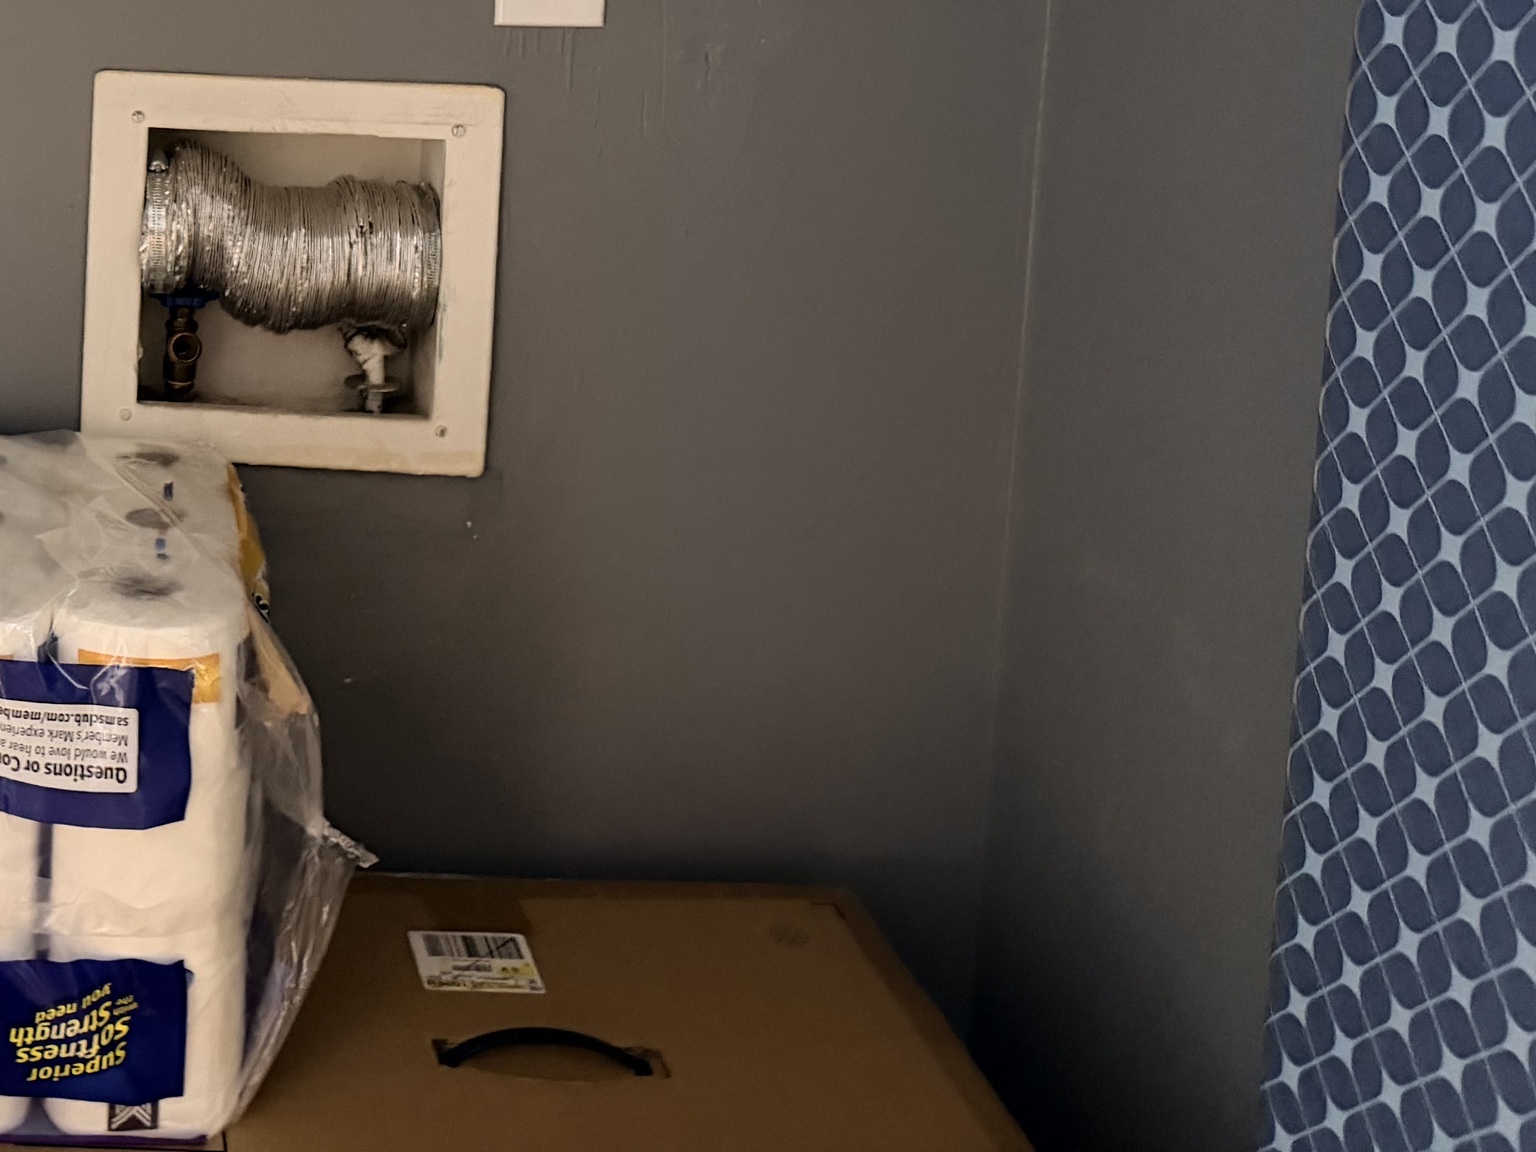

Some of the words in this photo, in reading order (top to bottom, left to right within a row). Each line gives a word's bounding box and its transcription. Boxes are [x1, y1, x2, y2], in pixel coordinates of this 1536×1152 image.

[47, 727, 75, 743] Mark
[76, 730, 129, 747] Member's
[8, 742, 32, 755] hear
[34, 745, 47, 755] to
[47, 746, 72, 759] love
[73, 747, 108, 760] would
[110, 751, 128, 764] We
[23, 759, 40, 773] or
[44, 761, 127, 784] Questions
[81, 982, 113, 1009] you
[34, 1002, 78, 1023] need
[9, 1001, 113, 1047] Strength
